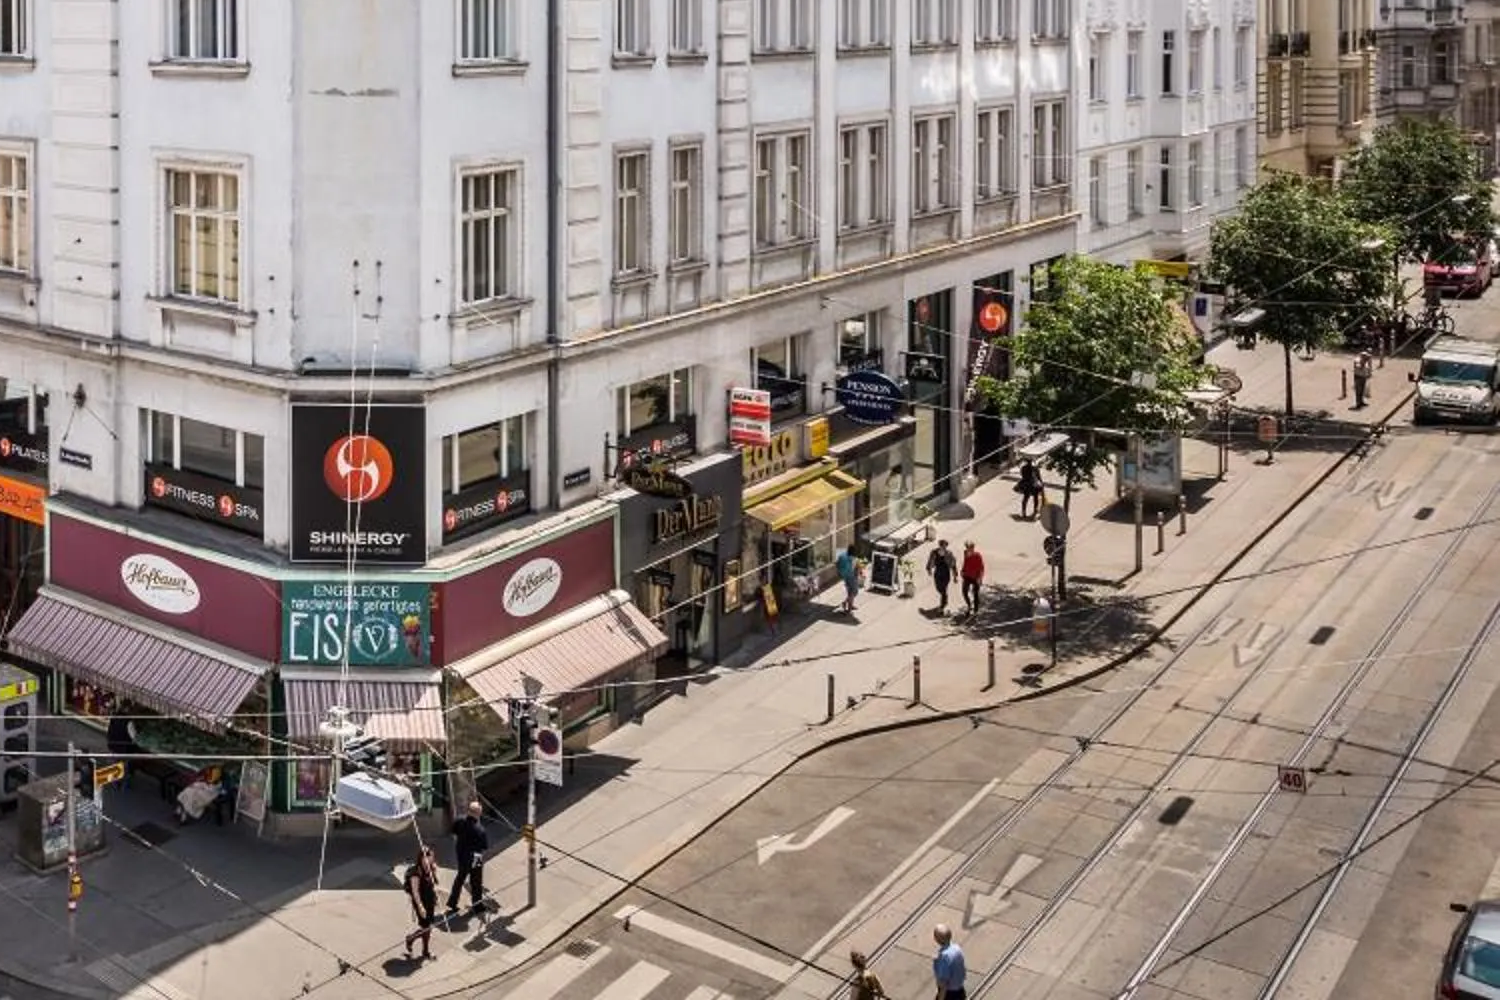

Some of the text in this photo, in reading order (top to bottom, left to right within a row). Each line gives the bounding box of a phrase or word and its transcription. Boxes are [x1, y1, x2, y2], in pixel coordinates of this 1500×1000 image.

[847, 380, 892, 395] PENSION
[12, 444, 49, 464] PILATES
[165, 483, 260, 521] FITNESS SPA
[456, 489, 526, 521] FITNESS SPA
[309, 531, 406, 546] SHINERGY
[125, 561, 195, 597] Hofbauer
[313, 584, 400, 599] ENGELECKE
[289, 611, 343, 661] EIS
